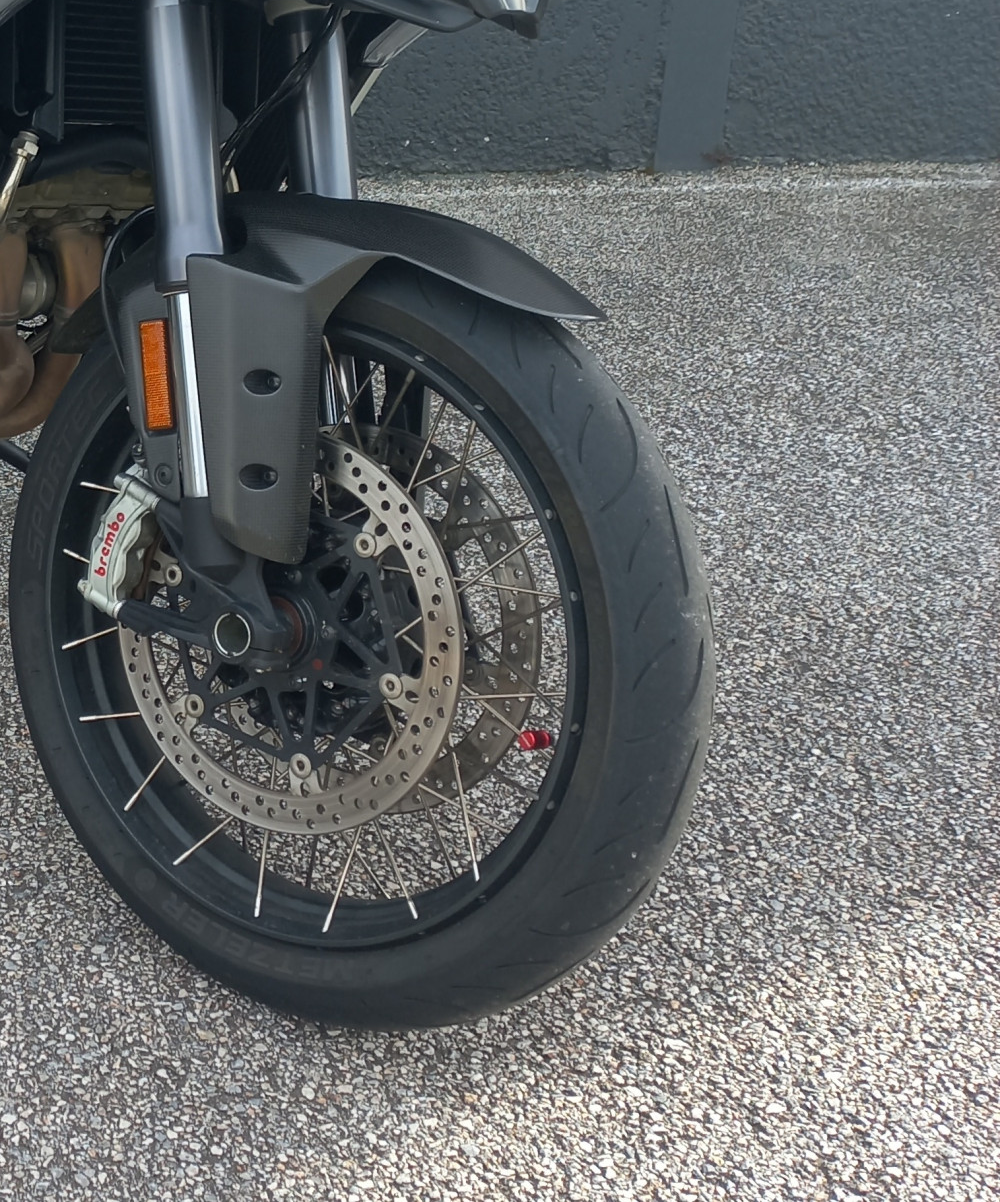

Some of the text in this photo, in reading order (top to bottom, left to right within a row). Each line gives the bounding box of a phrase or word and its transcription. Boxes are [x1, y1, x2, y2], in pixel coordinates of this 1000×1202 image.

[26, 377, 108, 570] SPORTEC
[94, 511, 125, 577] brembo
[160, 892, 355, 982] METZELER
